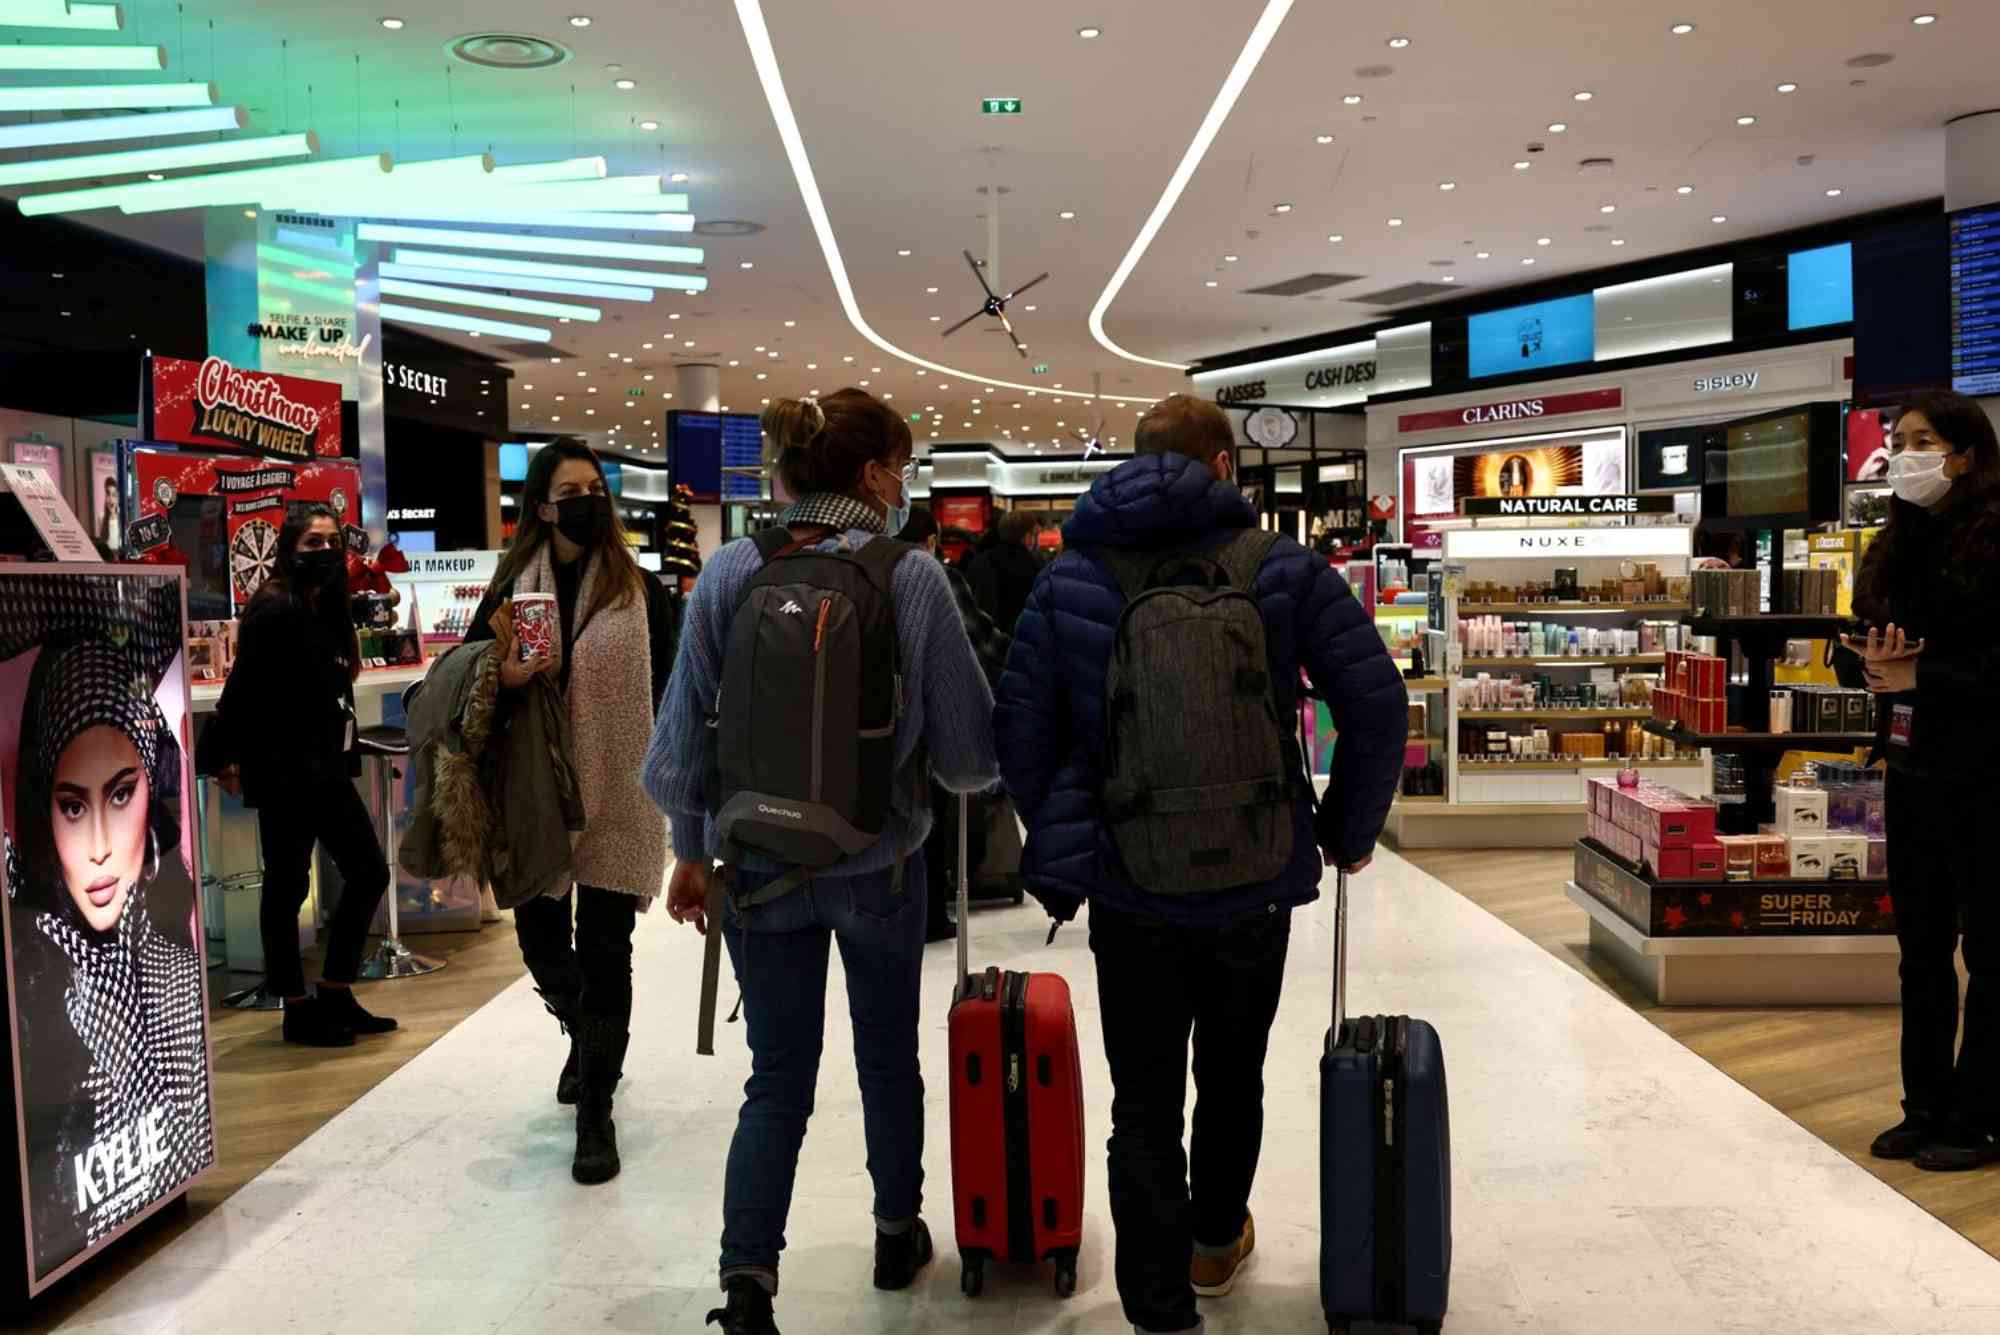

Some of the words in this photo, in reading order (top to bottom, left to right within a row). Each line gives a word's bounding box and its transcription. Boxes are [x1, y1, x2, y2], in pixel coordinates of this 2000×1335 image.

[248, 323, 308, 341] #MAKE
[320, 327, 344, 342] UP
[399, 364, 447, 397] SECRET
[1305, 365, 1343, 391] CASH
[198, 356, 319, 435] Christmas
[1216, 380, 1267, 407] CAISSES
[1462, 400, 1544, 424] CLARINS
[200, 408, 258, 441] LUCKY
[257, 421, 309, 456] WHEEL
[1500, 498, 1585, 513] NATURAL
[1589, 497, 1638, 512] CARE
[1520, 536, 1585, 548] NUXE
[425, 558, 475, 572] MAKEUP
[1760, 894, 1832, 910] SUPER
[1790, 911, 1860, 926] FRIDAY
[74, 1103, 171, 1213] KYLIE
